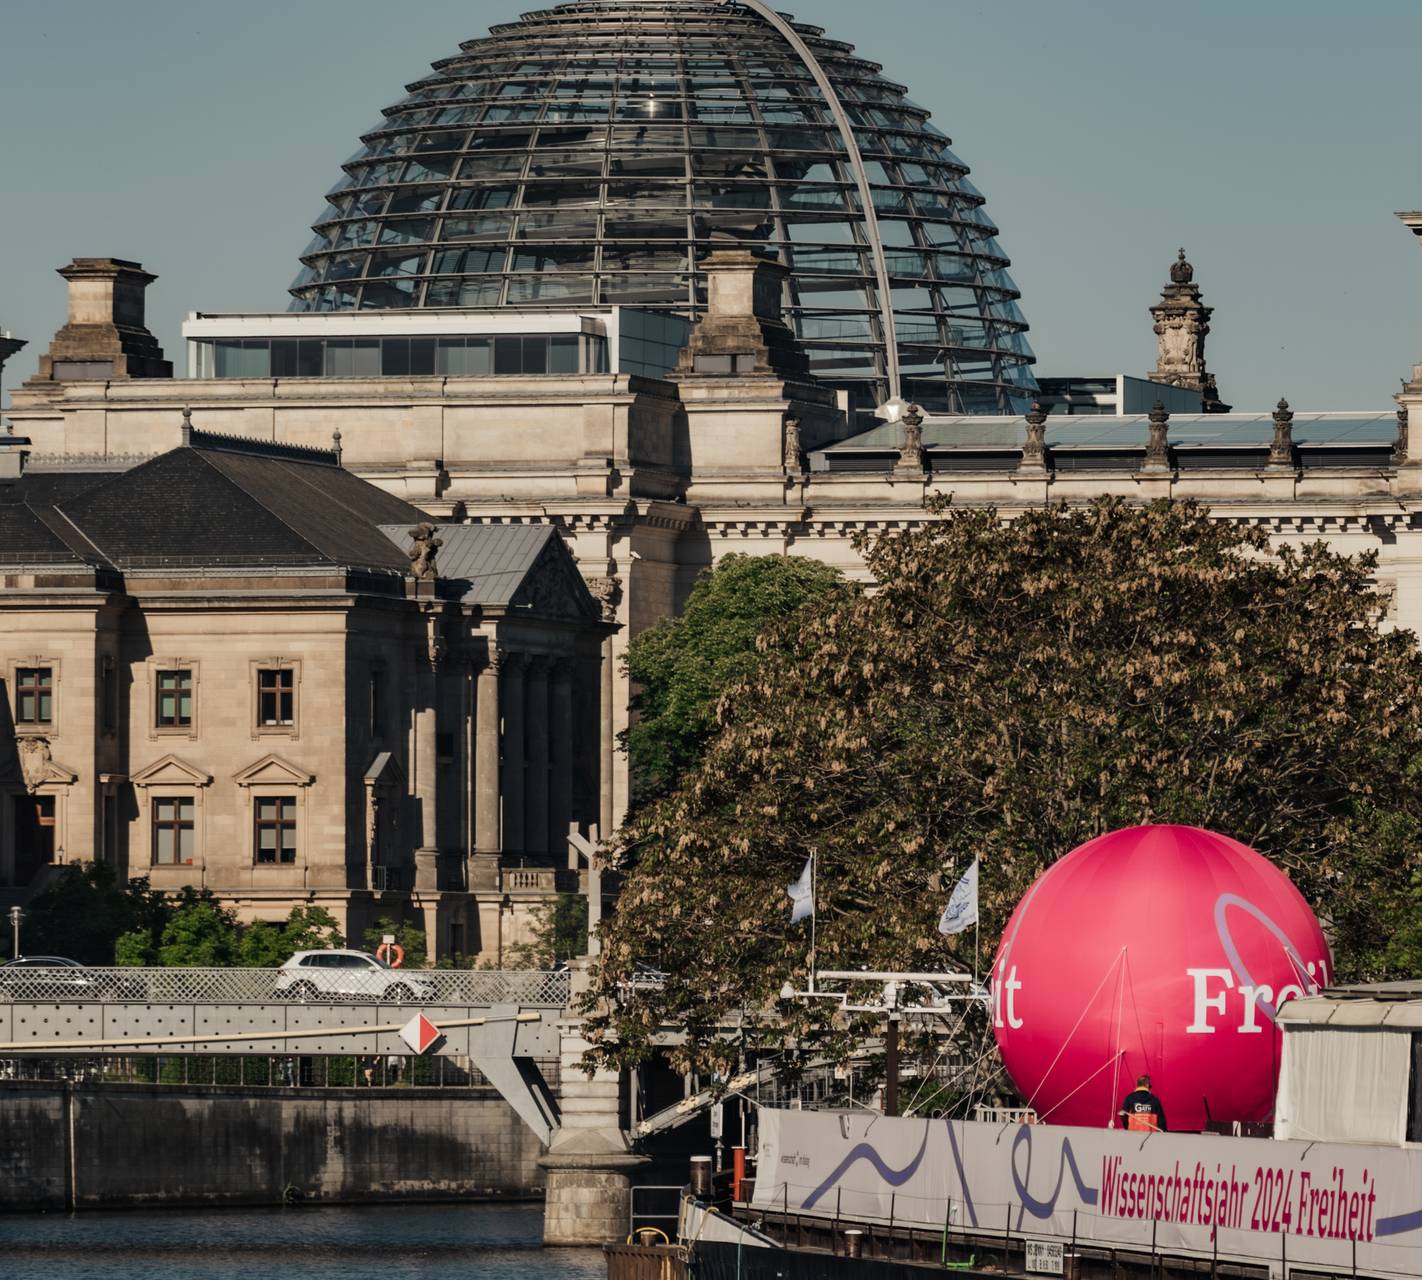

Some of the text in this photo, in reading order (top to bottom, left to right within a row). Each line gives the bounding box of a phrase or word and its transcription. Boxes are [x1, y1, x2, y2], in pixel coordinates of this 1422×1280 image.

[1101, 1155, 1376, 1242] Wissenschaftsjahr 2024 Freiheit
